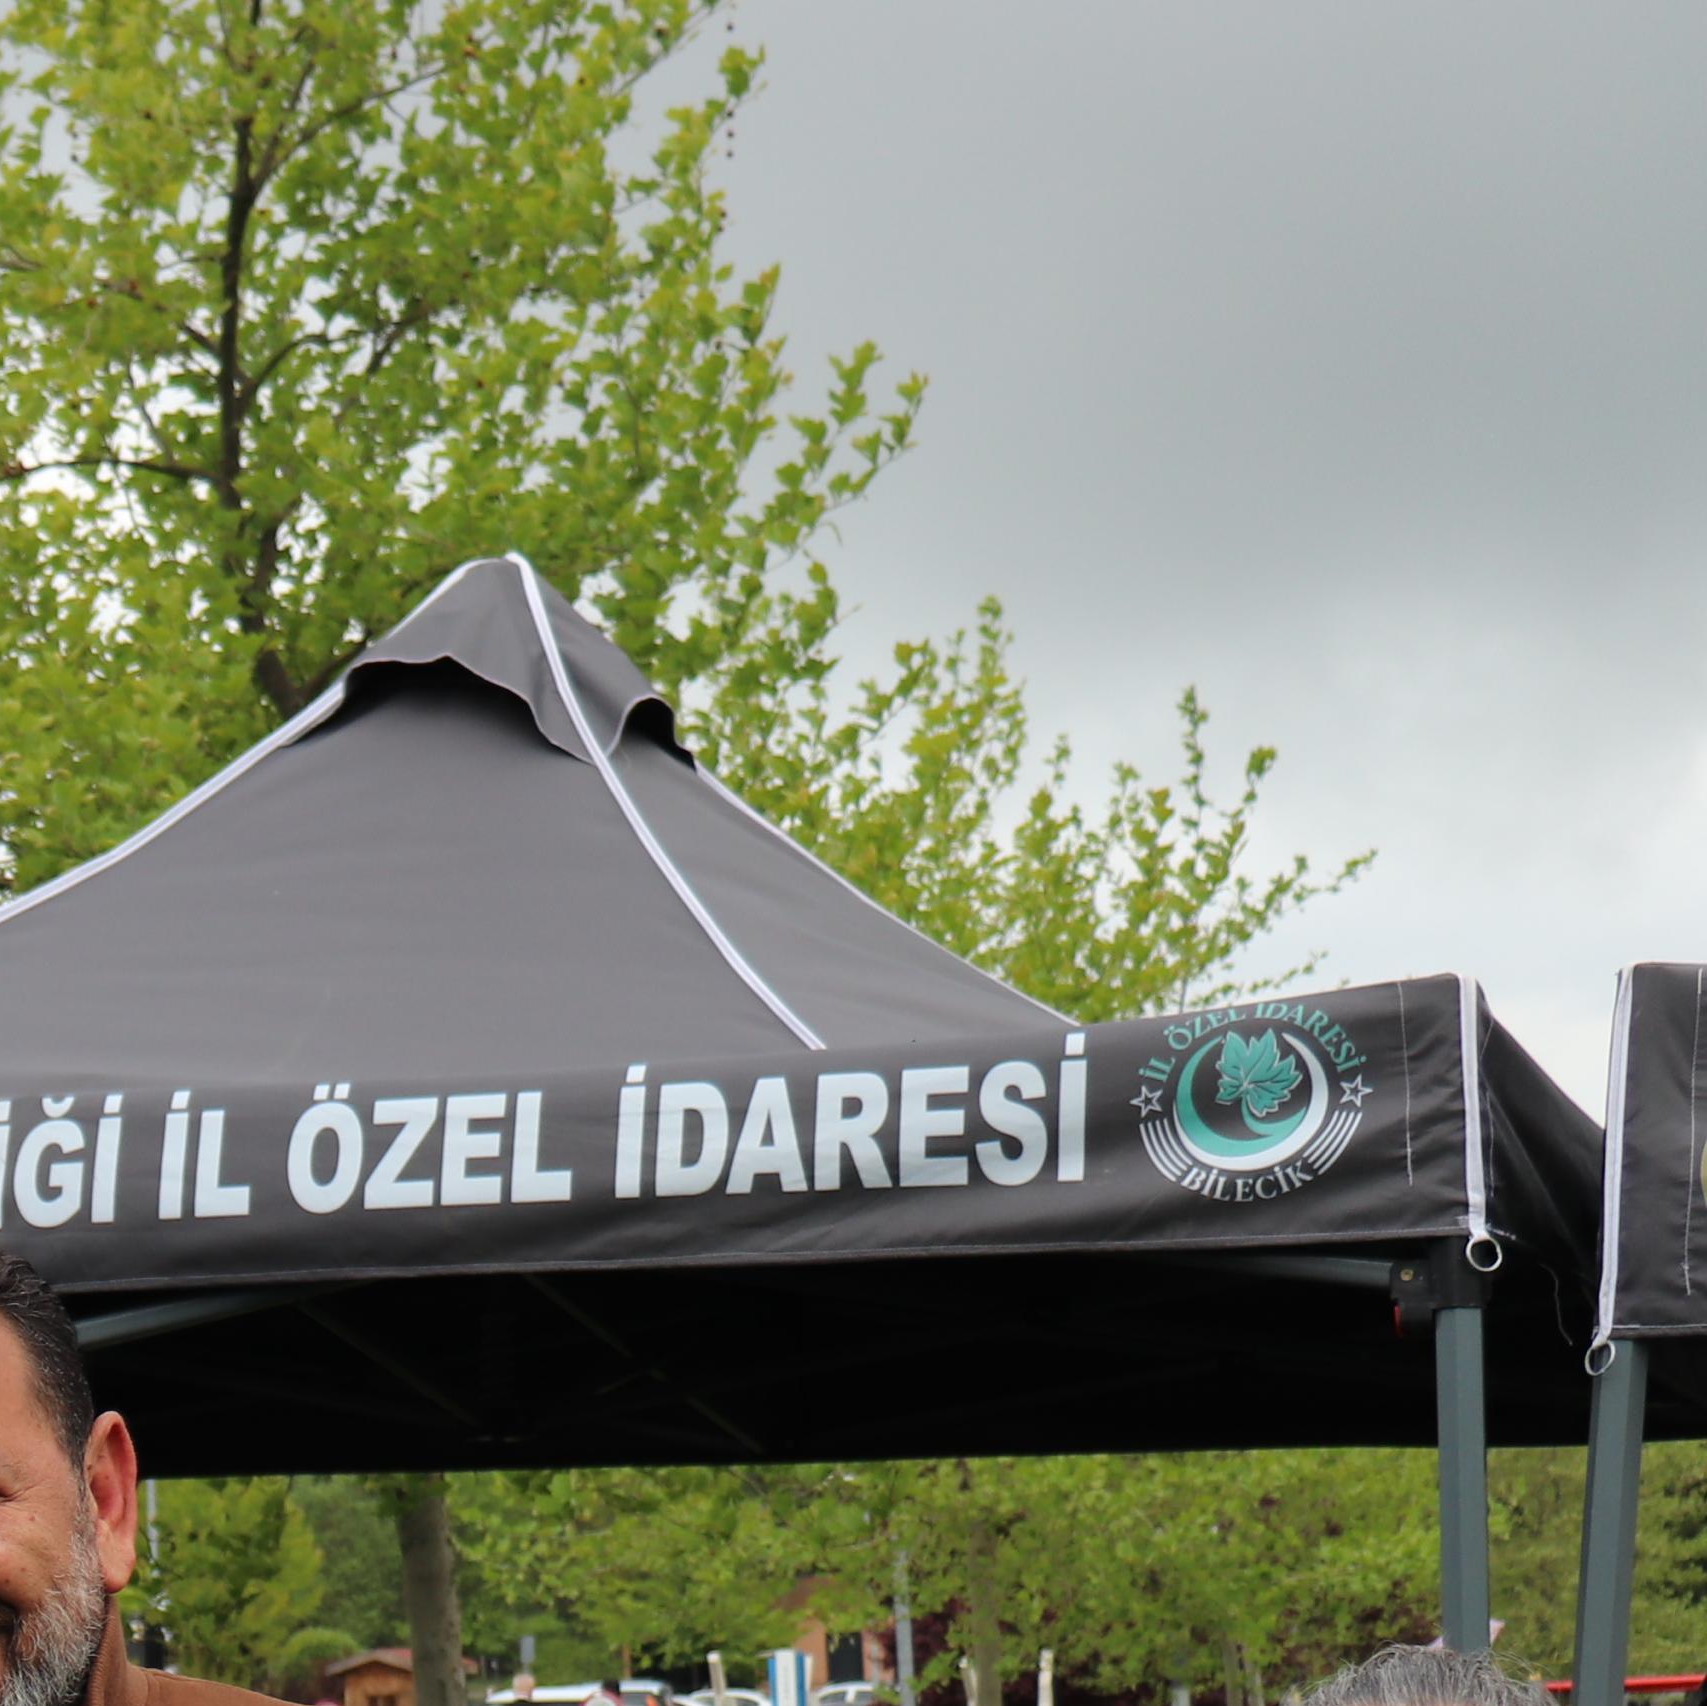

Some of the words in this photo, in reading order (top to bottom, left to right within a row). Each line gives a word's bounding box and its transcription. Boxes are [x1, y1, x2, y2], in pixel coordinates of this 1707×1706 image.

[1163, 1006, 1247, 1050] ÖZEL
[158, 1089, 252, 1221] İL
[286, 1082, 574, 1214] ÖZEL
[614, 1032, 1088, 1199] İDARESİ
[1180, 1162, 1314, 1202] BİLECİK
